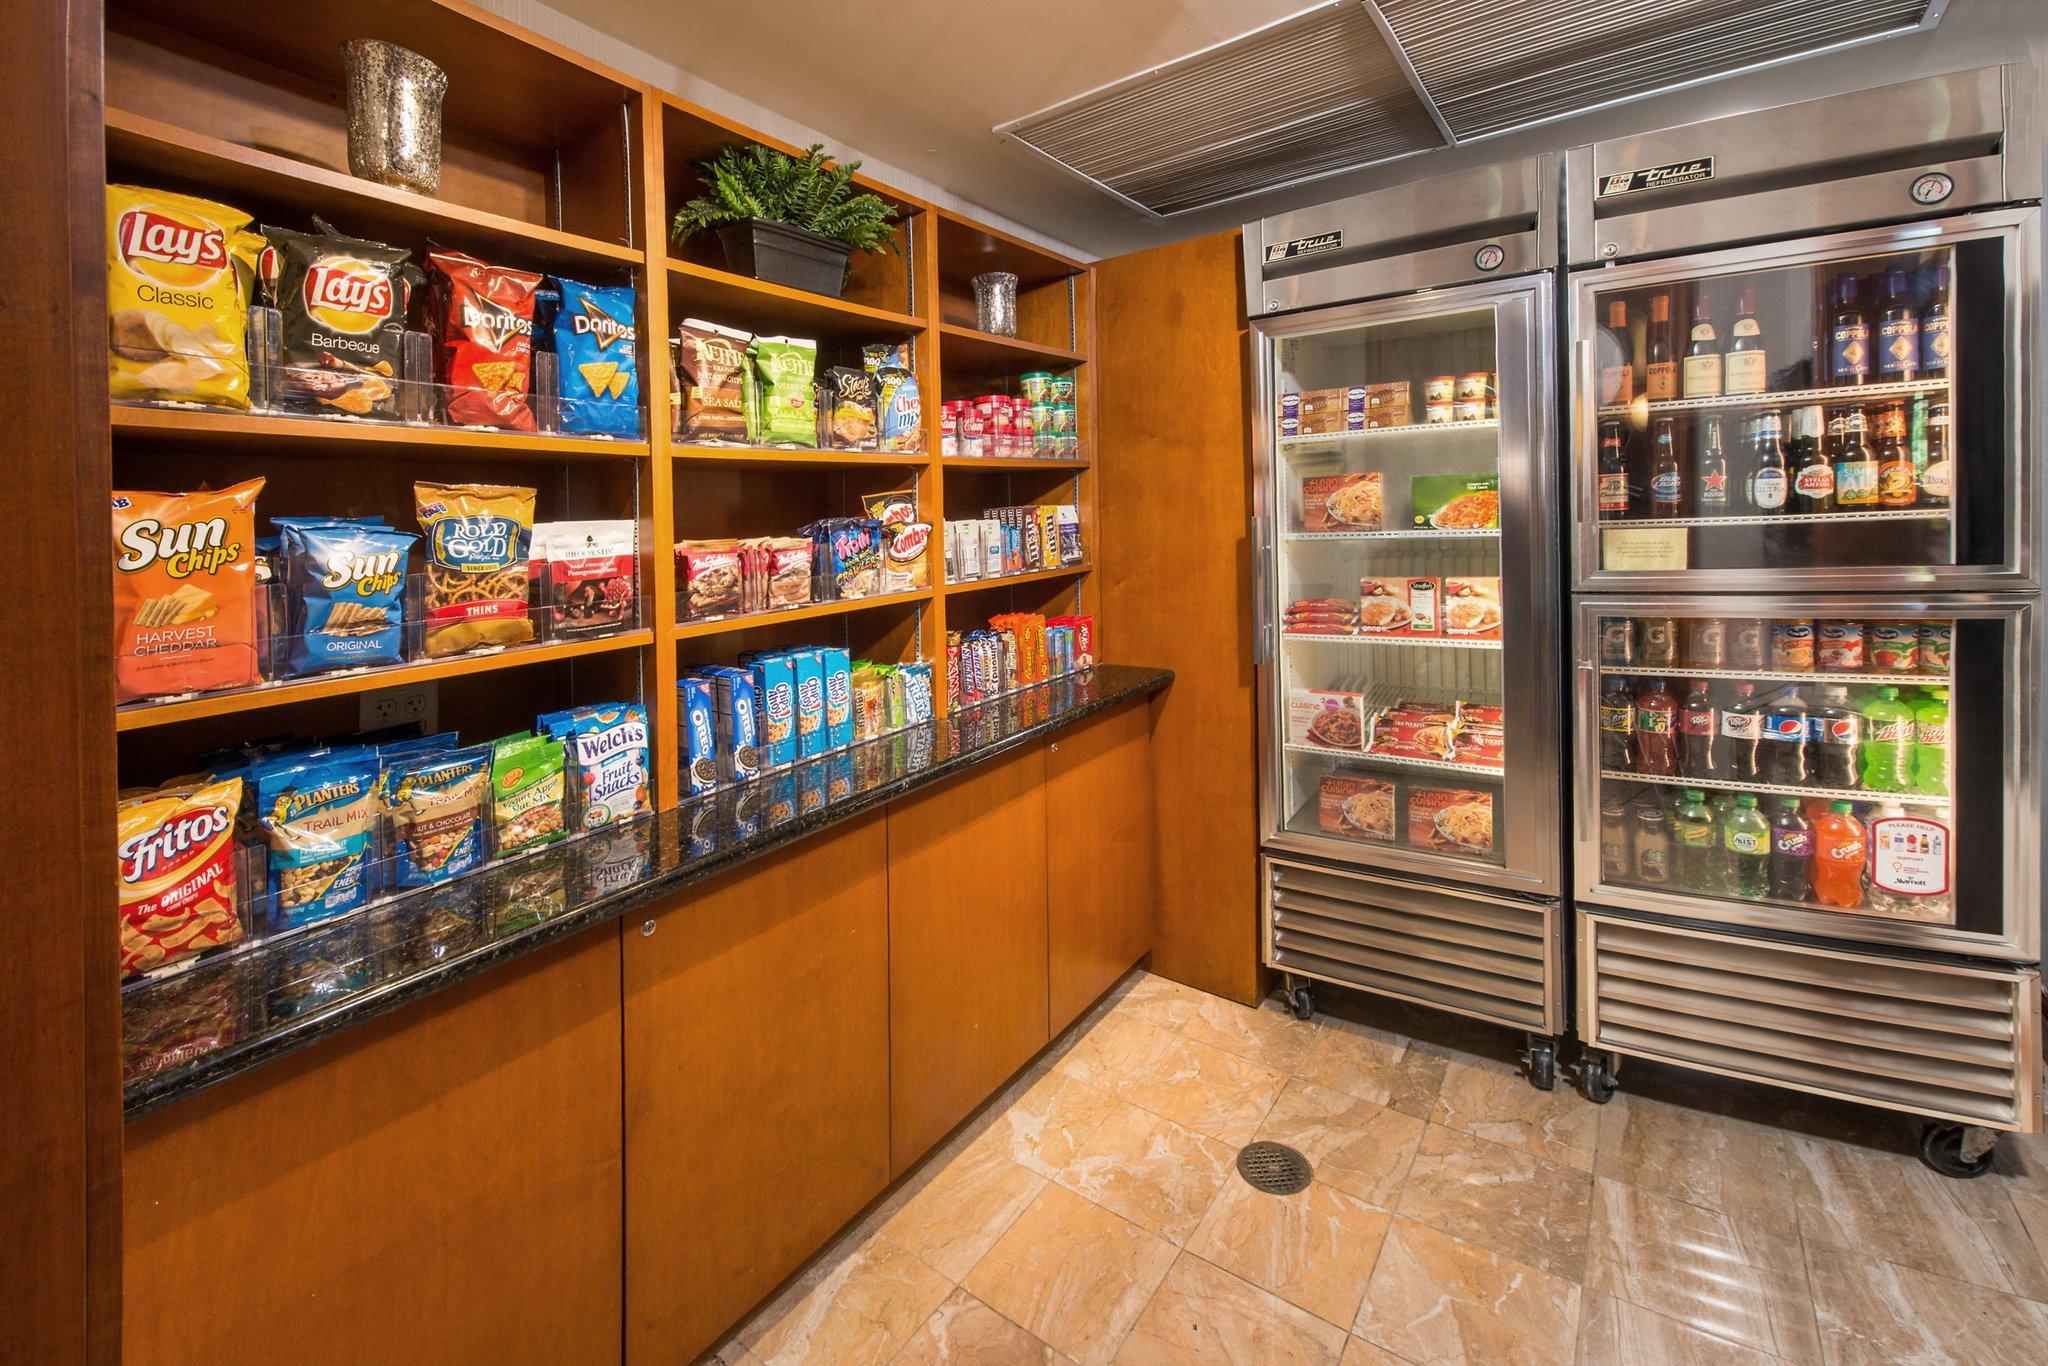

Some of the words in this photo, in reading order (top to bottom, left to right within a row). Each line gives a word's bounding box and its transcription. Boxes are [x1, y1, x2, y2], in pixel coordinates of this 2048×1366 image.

[1646, 172, 1706, 187] REFRIGERATOR
[128, 212, 223, 265] Lay's
[1297, 243, 1338, 255] REFRIGERATOR
[137, 284, 214, 310] Classic
[311, 267, 388, 313] Lay's
[574, 315, 636, 340] Doritos
[311, 333, 381, 354] Barbecue
[703, 397, 722, 407] SEA
[453, 522, 508, 539] ROLD
[117, 517, 227, 574] Sun
[448, 537, 508, 558] GOLD
[166, 542, 241, 579] Chips
[322, 551, 400, 590] Sun
[357, 572, 401, 597] Chips
[466, 605, 498, 616] THINS
[136, 625, 216, 645] HARVEST
[326, 640, 383, 652] ORIGINAL
[133, 638, 218, 658] CHEDDAR
[692, 708, 709, 755] OREO
[735, 697, 753, 743] OREO
[582, 726, 644, 760] Welch's
[420, 765, 473, 787] PLANTERS
[602, 761, 633, 786] Fruit
[292, 783, 361, 812] PLANTERS
[594, 772, 640, 801] Snacks
[304, 816, 344, 832] TRAIL
[346, 808, 370, 823] MIX
[436, 812, 472, 828] CHOCOLATE
[119, 805, 229, 884] Fritos
[1778, 833, 1807, 851] Crush
[1831, 841, 1862, 859] Crush
[161, 850, 195, 871] BRAND
[138, 904, 158, 916] The
[161, 862, 224, 908] ORIGINAL
[1894, 878, 1927, 886] Marriott
